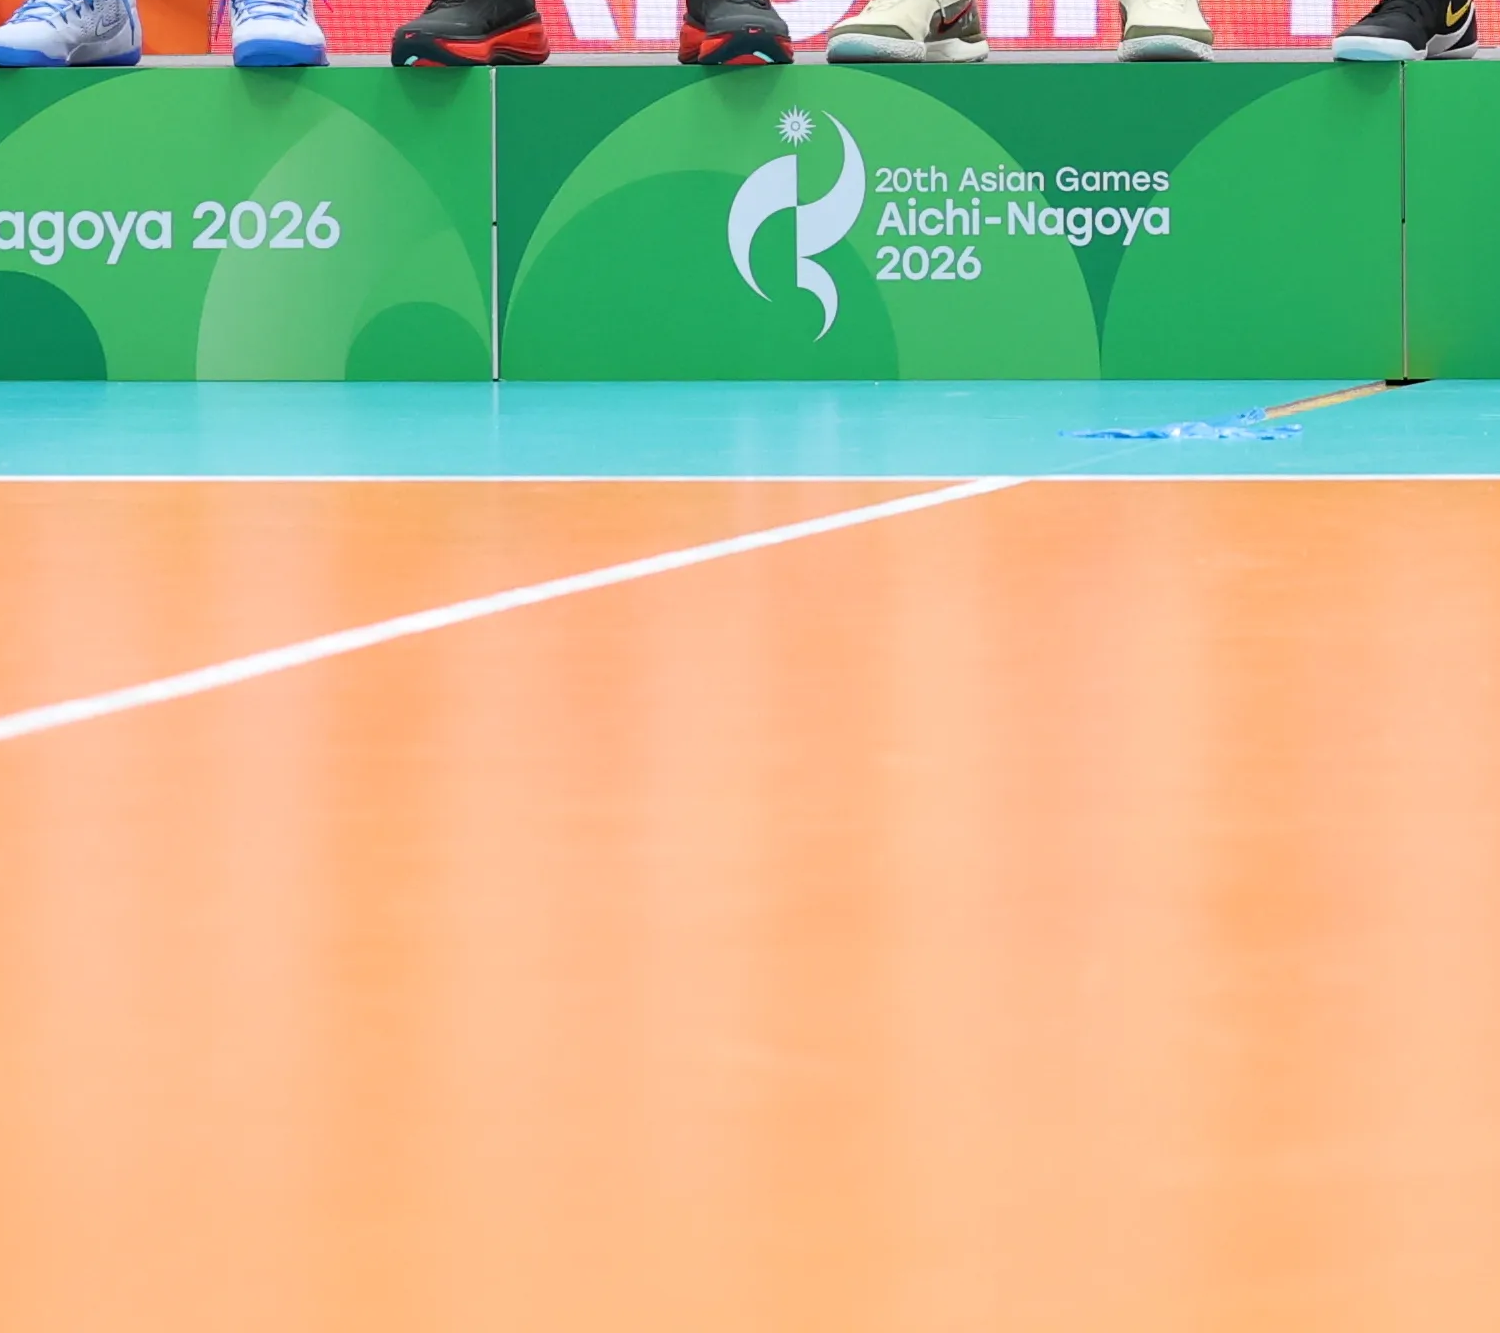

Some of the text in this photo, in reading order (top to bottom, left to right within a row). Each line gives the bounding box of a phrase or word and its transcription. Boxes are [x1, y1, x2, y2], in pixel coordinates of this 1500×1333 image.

[876, 165, 1169, 192] 20th Asian Games
[192, 200, 341, 249] 2026
[876, 198, 1170, 246] Aichi-Nagoya
[876, 246, 981, 280] 2026
